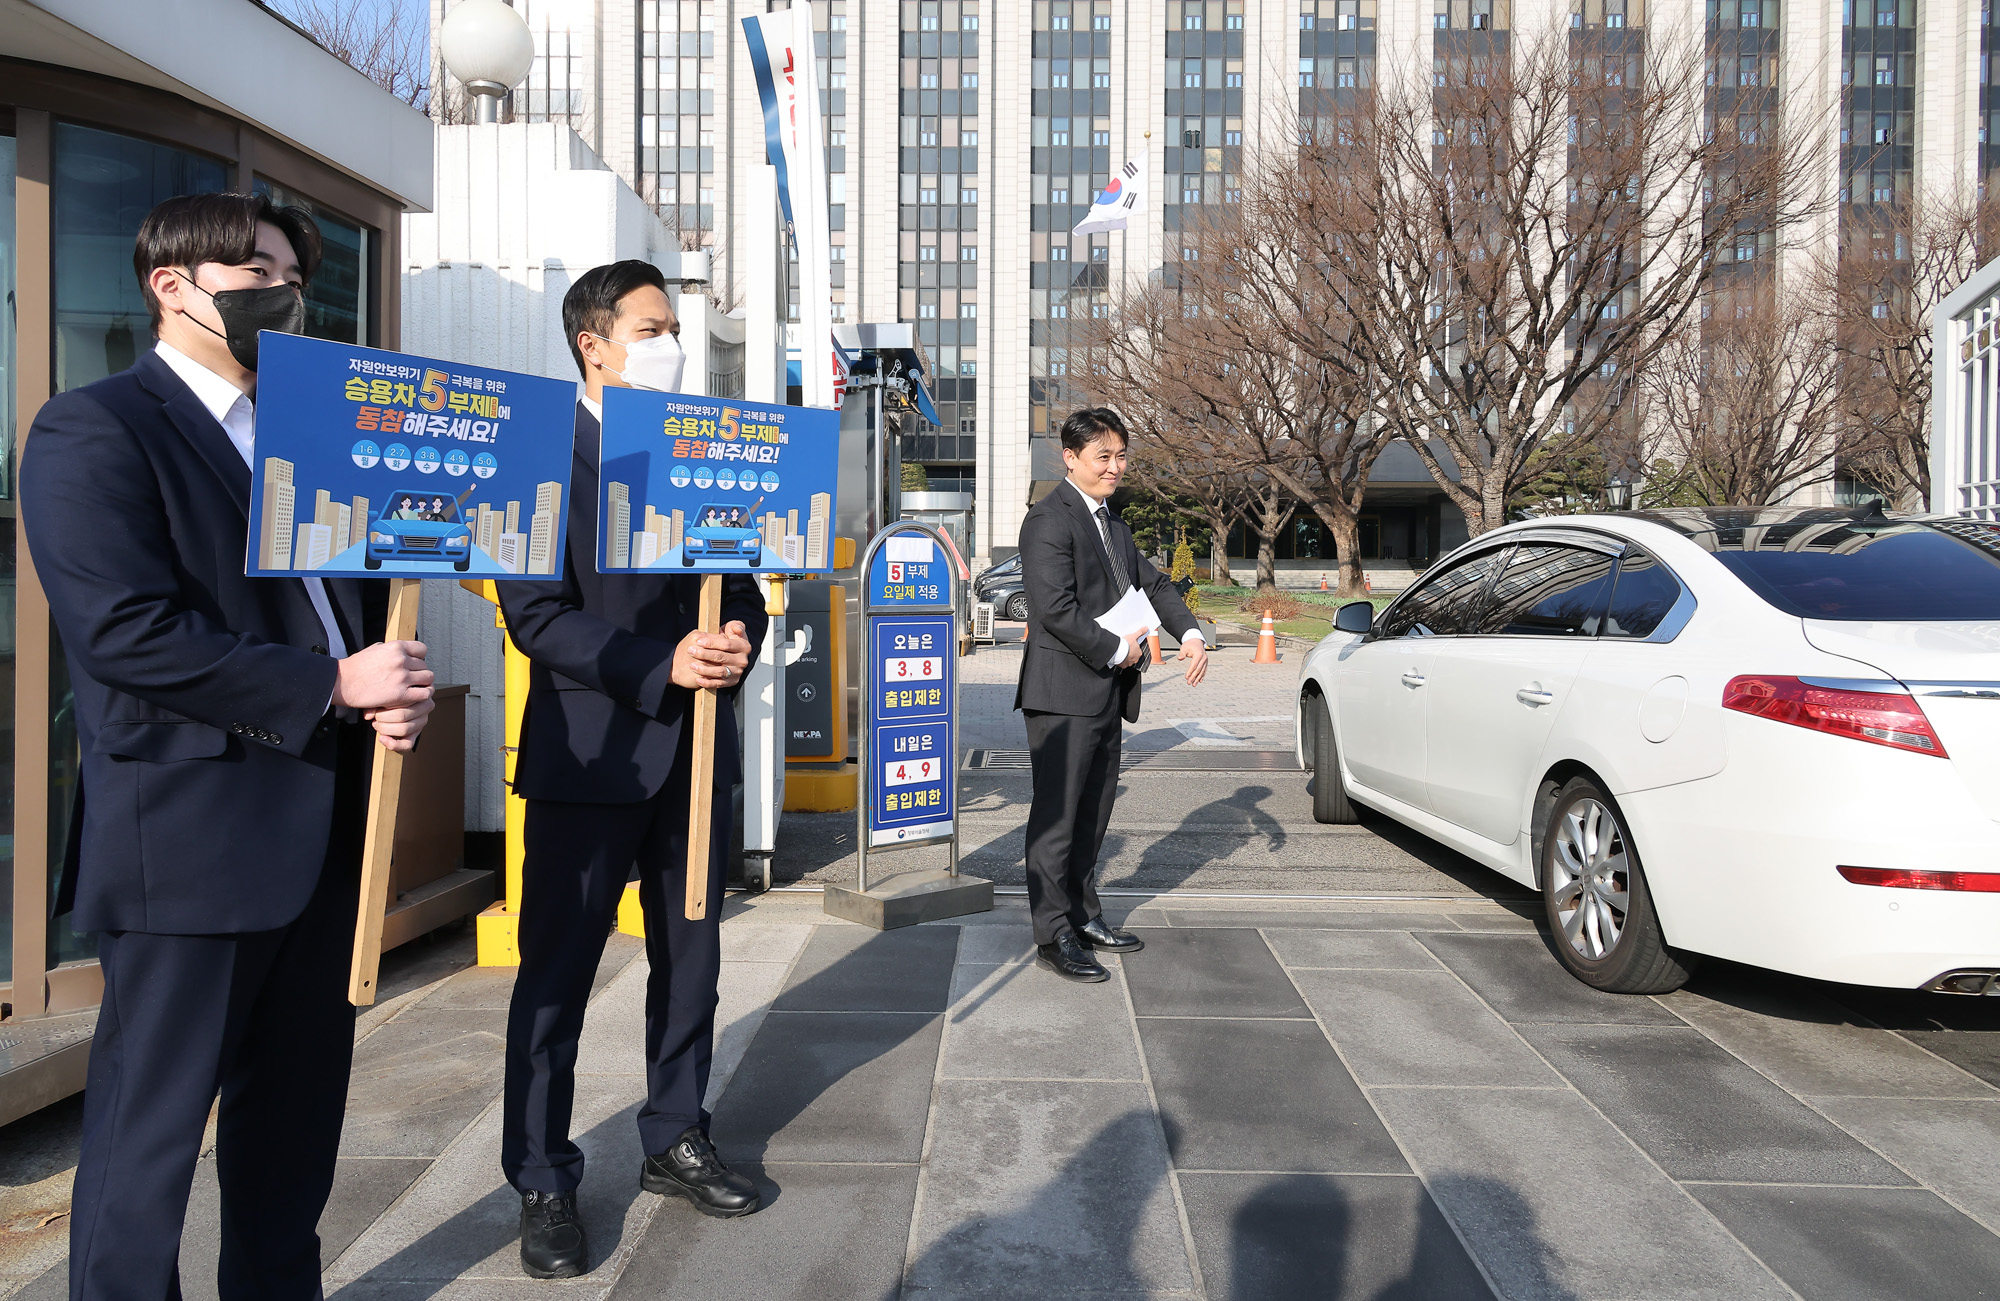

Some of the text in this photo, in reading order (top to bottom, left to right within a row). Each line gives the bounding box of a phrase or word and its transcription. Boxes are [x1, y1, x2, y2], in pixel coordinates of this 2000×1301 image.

[349, 358, 507, 394] 자원안보위기 극복을 위한
[345, 376, 417, 408] 승용차
[666, 402, 785, 424] 자원안보위기 극복을 위한
[355, 405, 500, 444] 동참해주세요!
[663, 416, 717, 439] 승용차
[672, 438, 780, 464] 동참해주세요!
[361, 457, 369, 467] 월
[392, 460, 401, 469] 화
[423, 463, 431, 471] 수
[452, 465, 460, 474] 목
[480, 468, 488, 476] 금
[891, 564, 929, 581] 5 부제
[883, 584, 939, 600] 요일제 적용
[894, 633, 933, 650] 오늘은
[884, 688, 942, 708] 출입제한
[894, 734, 933, 753] 내일은
[885, 788, 942, 812] 출입제한
